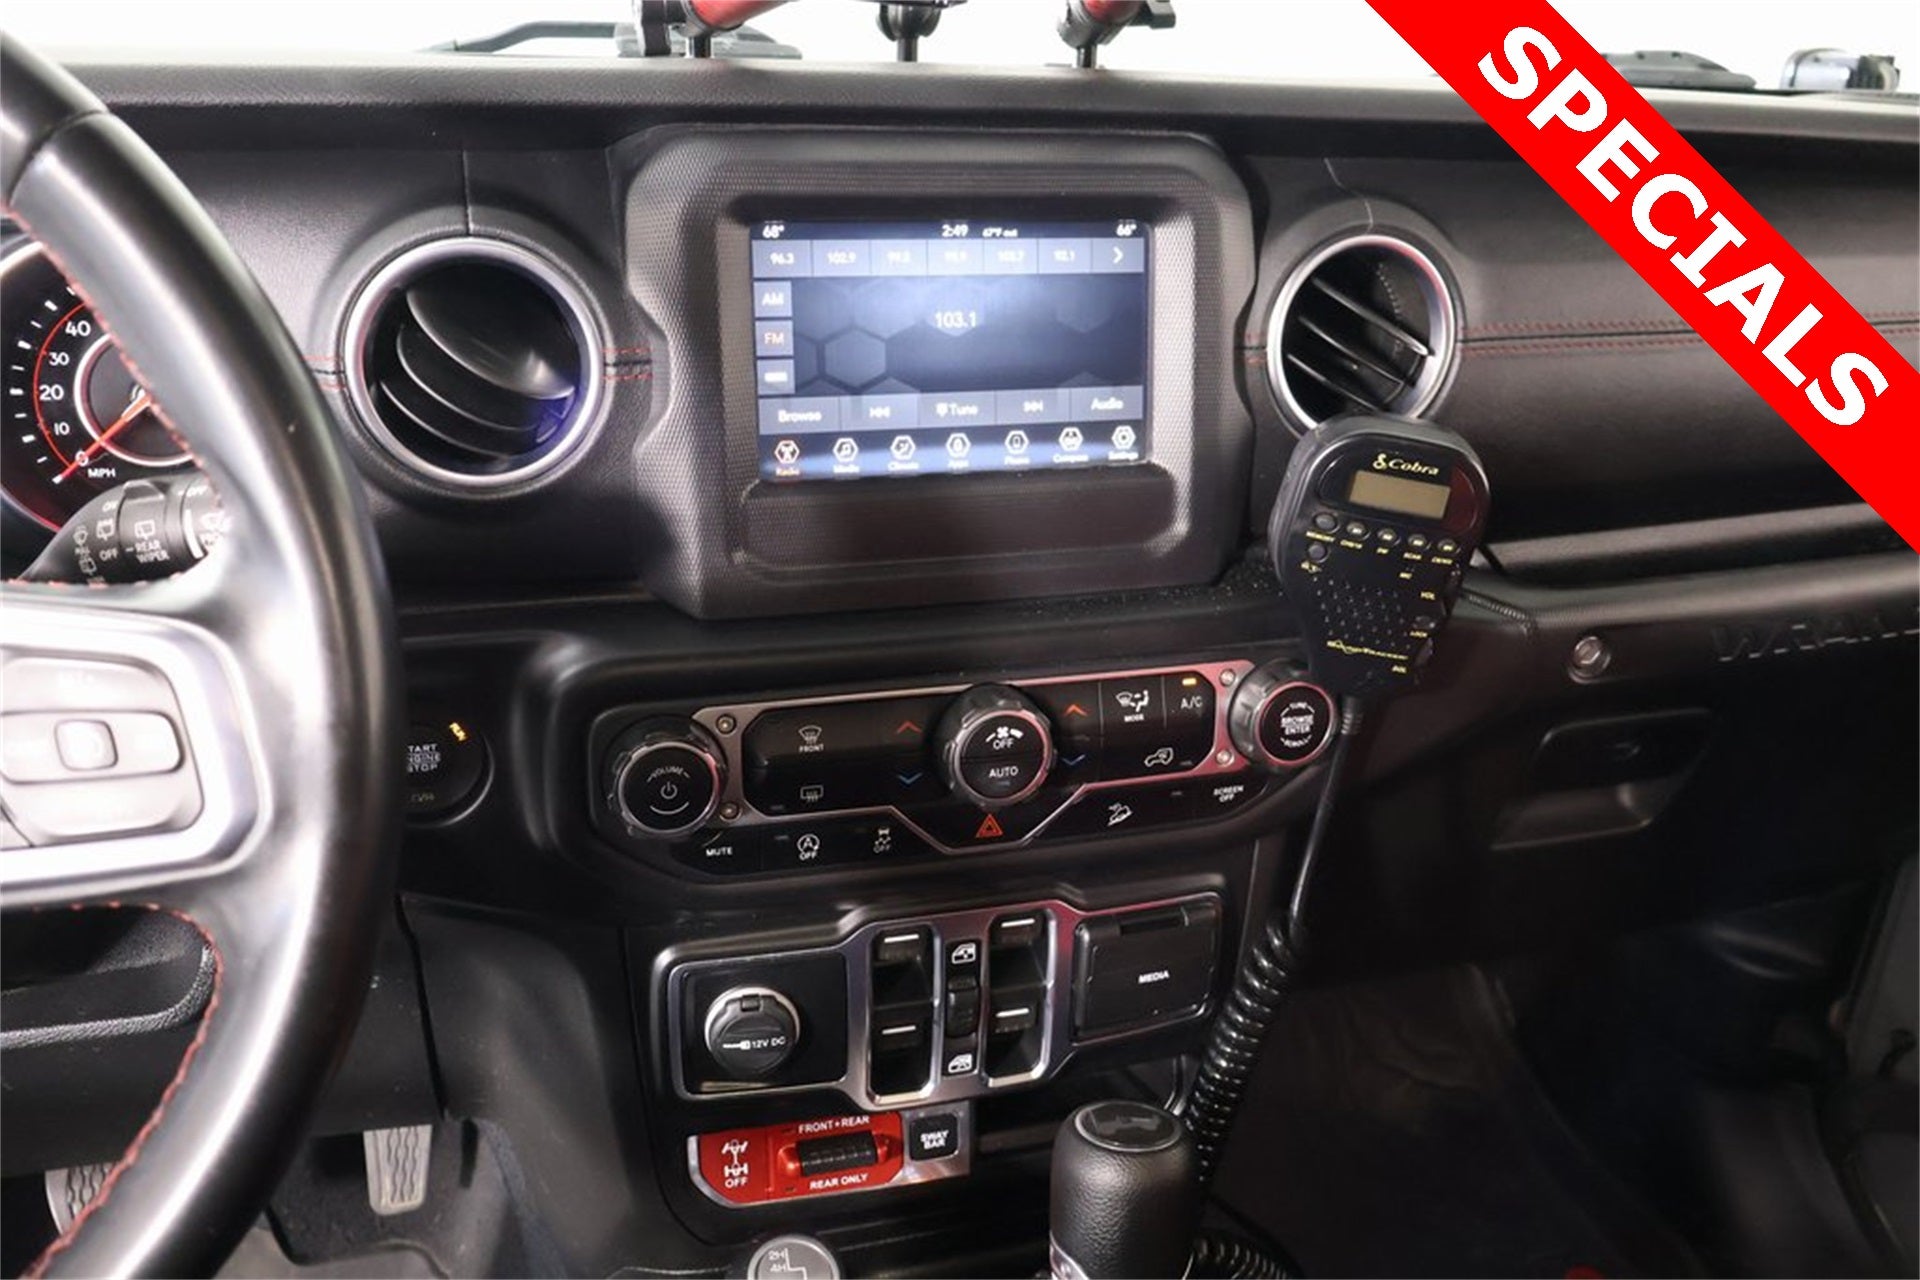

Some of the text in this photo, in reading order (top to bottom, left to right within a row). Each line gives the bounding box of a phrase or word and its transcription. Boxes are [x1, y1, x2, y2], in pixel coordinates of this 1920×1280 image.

[942, 224, 968, 238] 2:49
[762, 293, 784, 306] AM
[934, 311, 977, 328] 103.1
[65, 320, 91, 337] 40
[764, 332, 785, 345] FM
[49, 352, 70, 366] 30
[39, 384, 64, 401] 20
[951, 403, 979, 416] Tune
[1090, 397, 1124, 411] Audio
[778, 409, 822, 423] Browse
[53, 421, 70, 436] 10
[87, 467, 116, 478] MPH
[1389, 457, 1440, 476] Cobra
[99, 548, 118, 561] OFF
[1180, 696, 1203, 710] A/C
[404, 743, 438, 754] TART
[993, 740, 1014, 751] OFF
[988, 765, 1019, 778] AUTO
[706, 846, 733, 857] MUTE
[799, 850, 818, 861] OFF
[1137, 969, 1170, 984] MEDIA
[751, 1035, 786, 1050] 12V DC
[920, 1129, 949, 1143] SWAY
[923, 1138, 946, 1150] BAR
[724, 1178, 748, 1189] OFF
[809, 1173, 869, 1190] REAR ONLY
